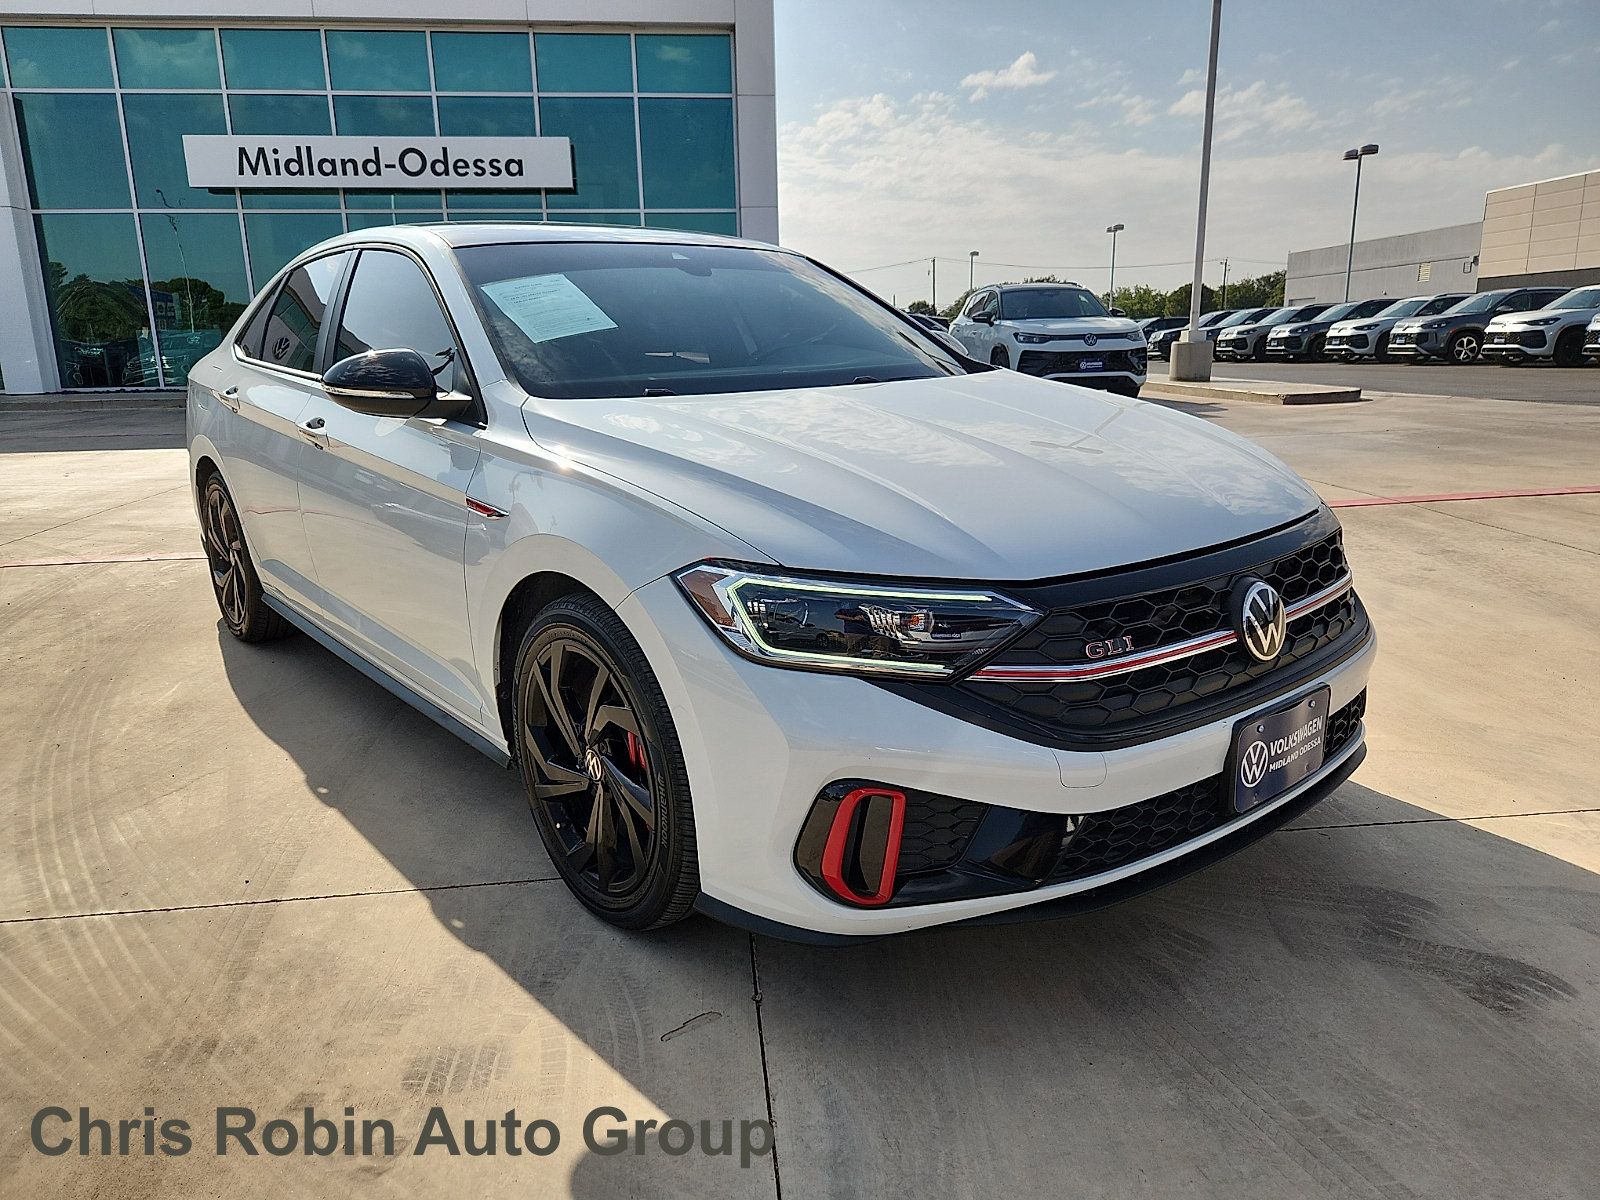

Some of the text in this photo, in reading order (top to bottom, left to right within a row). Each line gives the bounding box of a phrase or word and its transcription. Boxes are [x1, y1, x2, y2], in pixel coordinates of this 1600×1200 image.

[238, 146, 524, 178] Midland-Odessa
[1086, 635, 1134, 658] GLI
[1269, 716, 1323, 756] VOLKSWAGEN
[1269, 736, 1321, 772] MIDLAND ODESSA
